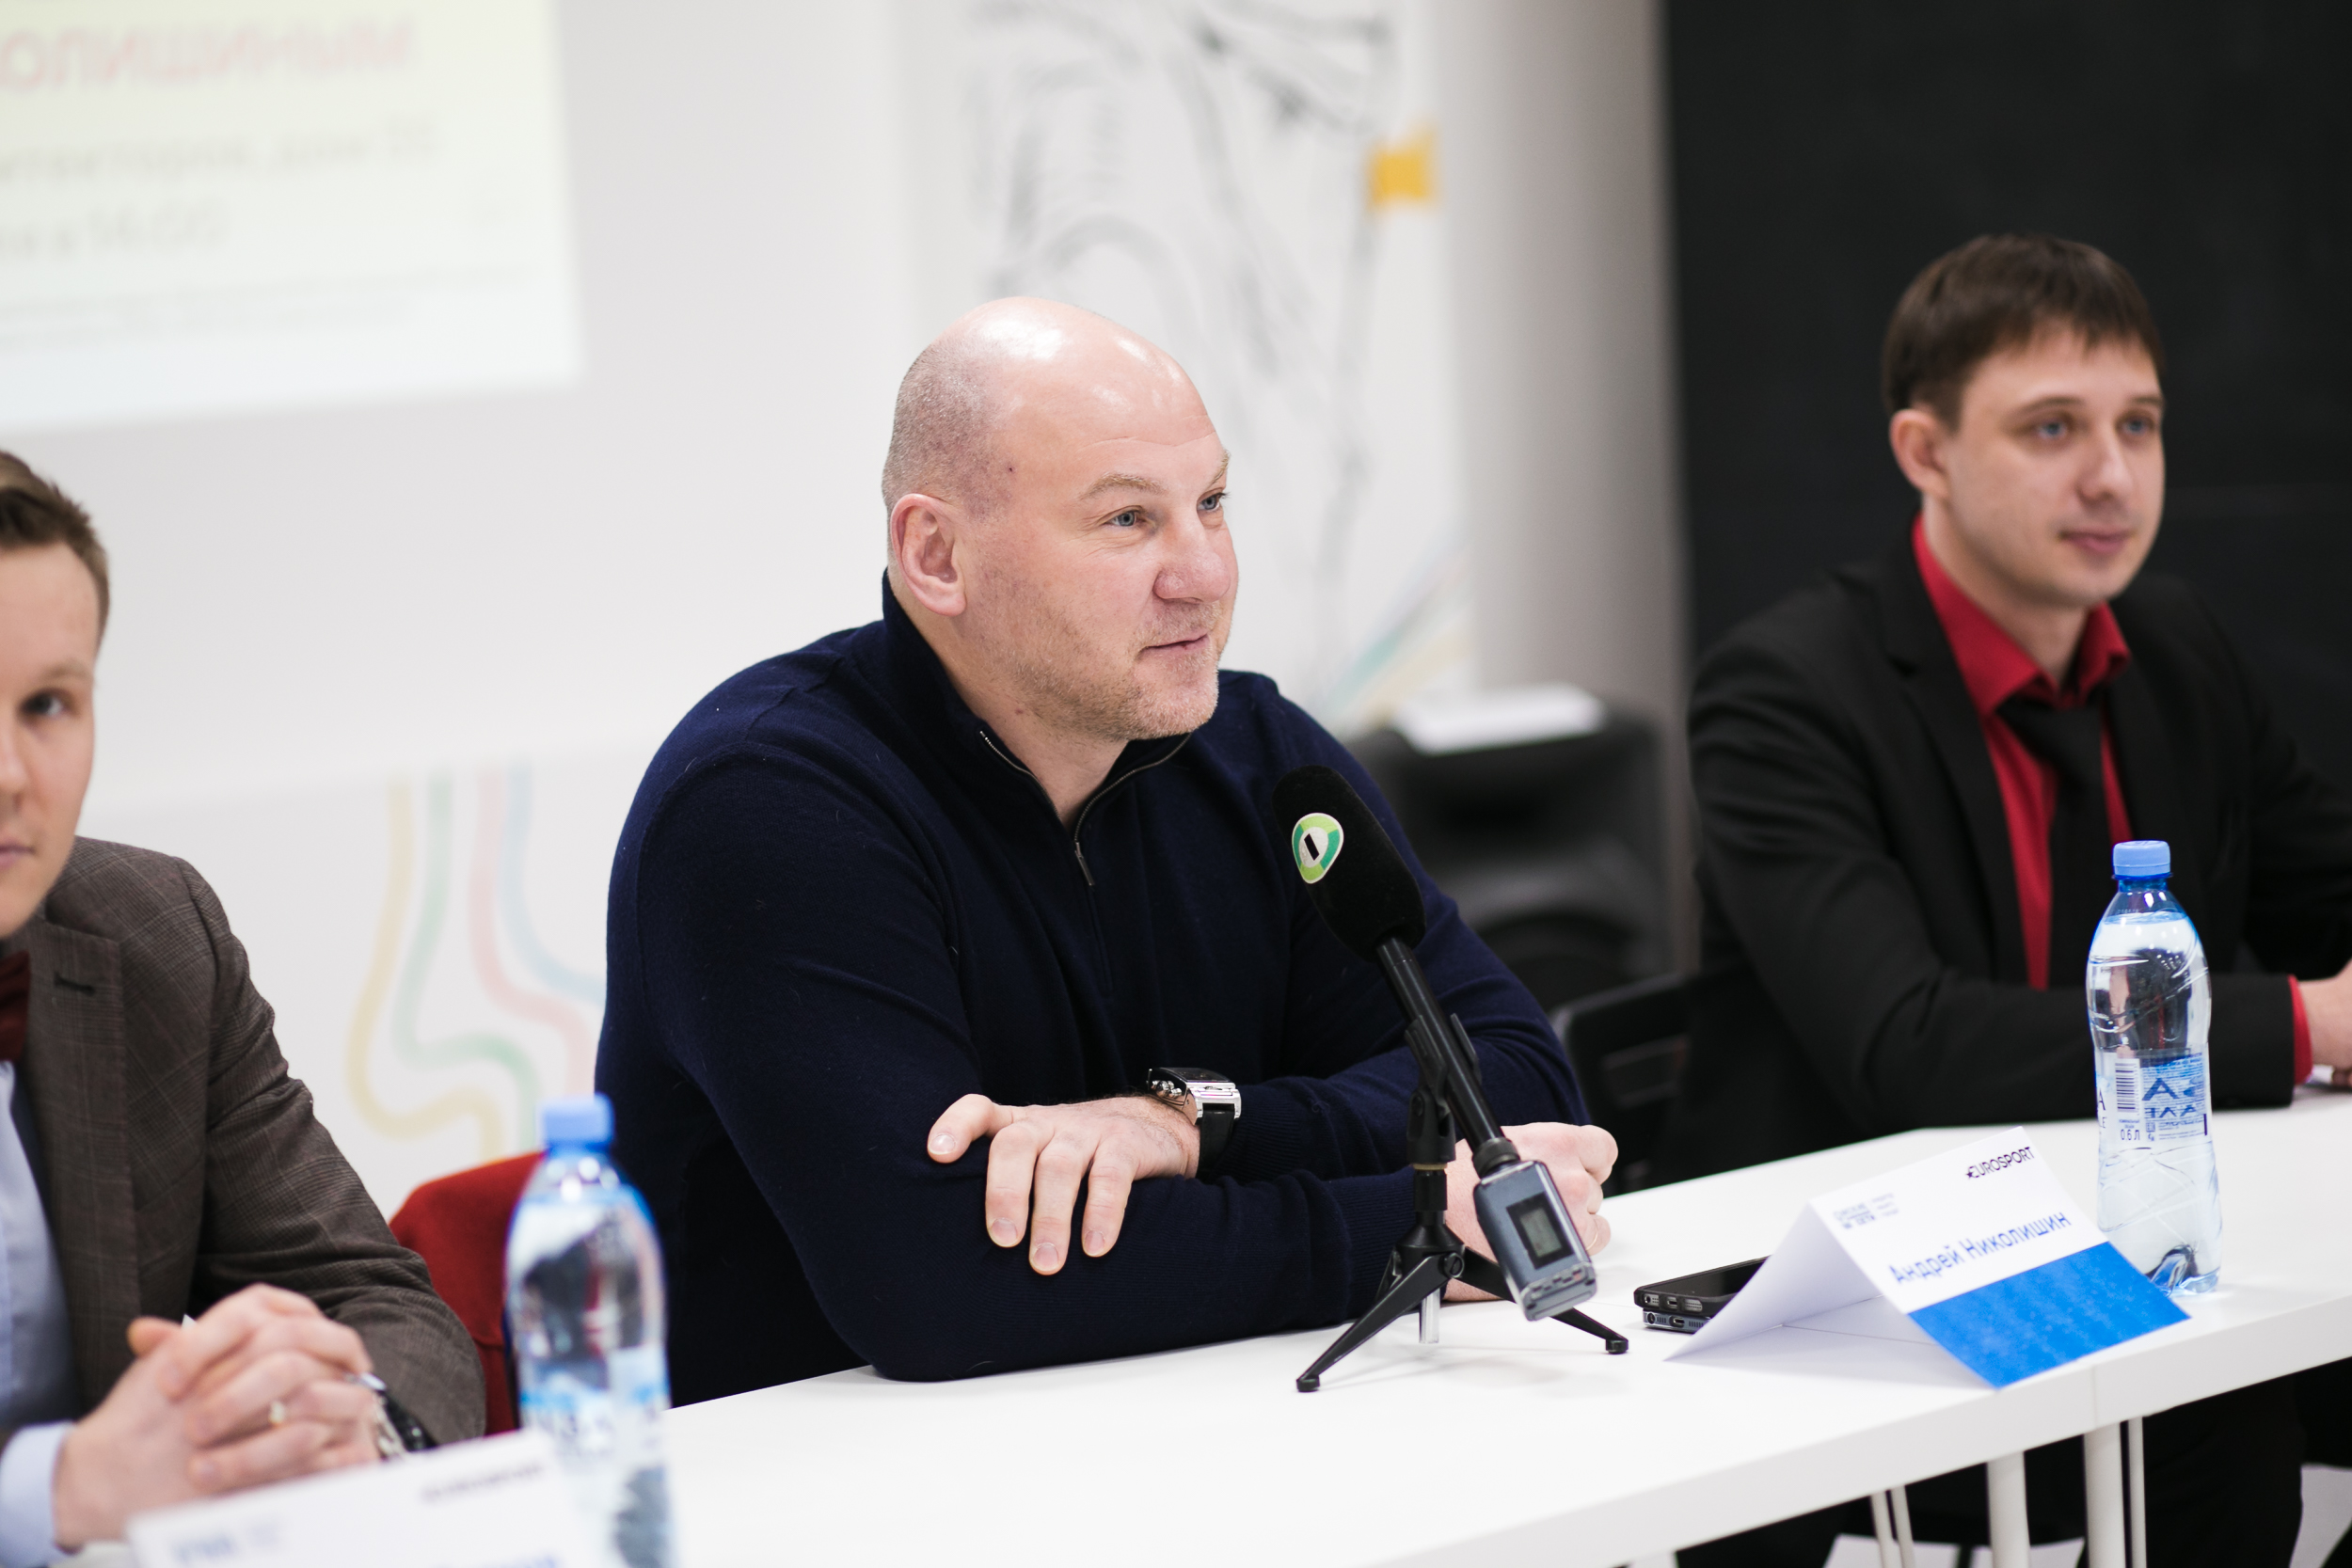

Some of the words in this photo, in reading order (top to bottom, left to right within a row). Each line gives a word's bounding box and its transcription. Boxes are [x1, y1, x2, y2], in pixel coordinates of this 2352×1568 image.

[1966, 1147, 2035, 1178] EUROSPORT
[1889, 1244, 1965, 1283] Андрей
[1959, 1212, 2072, 1259] Николишин
